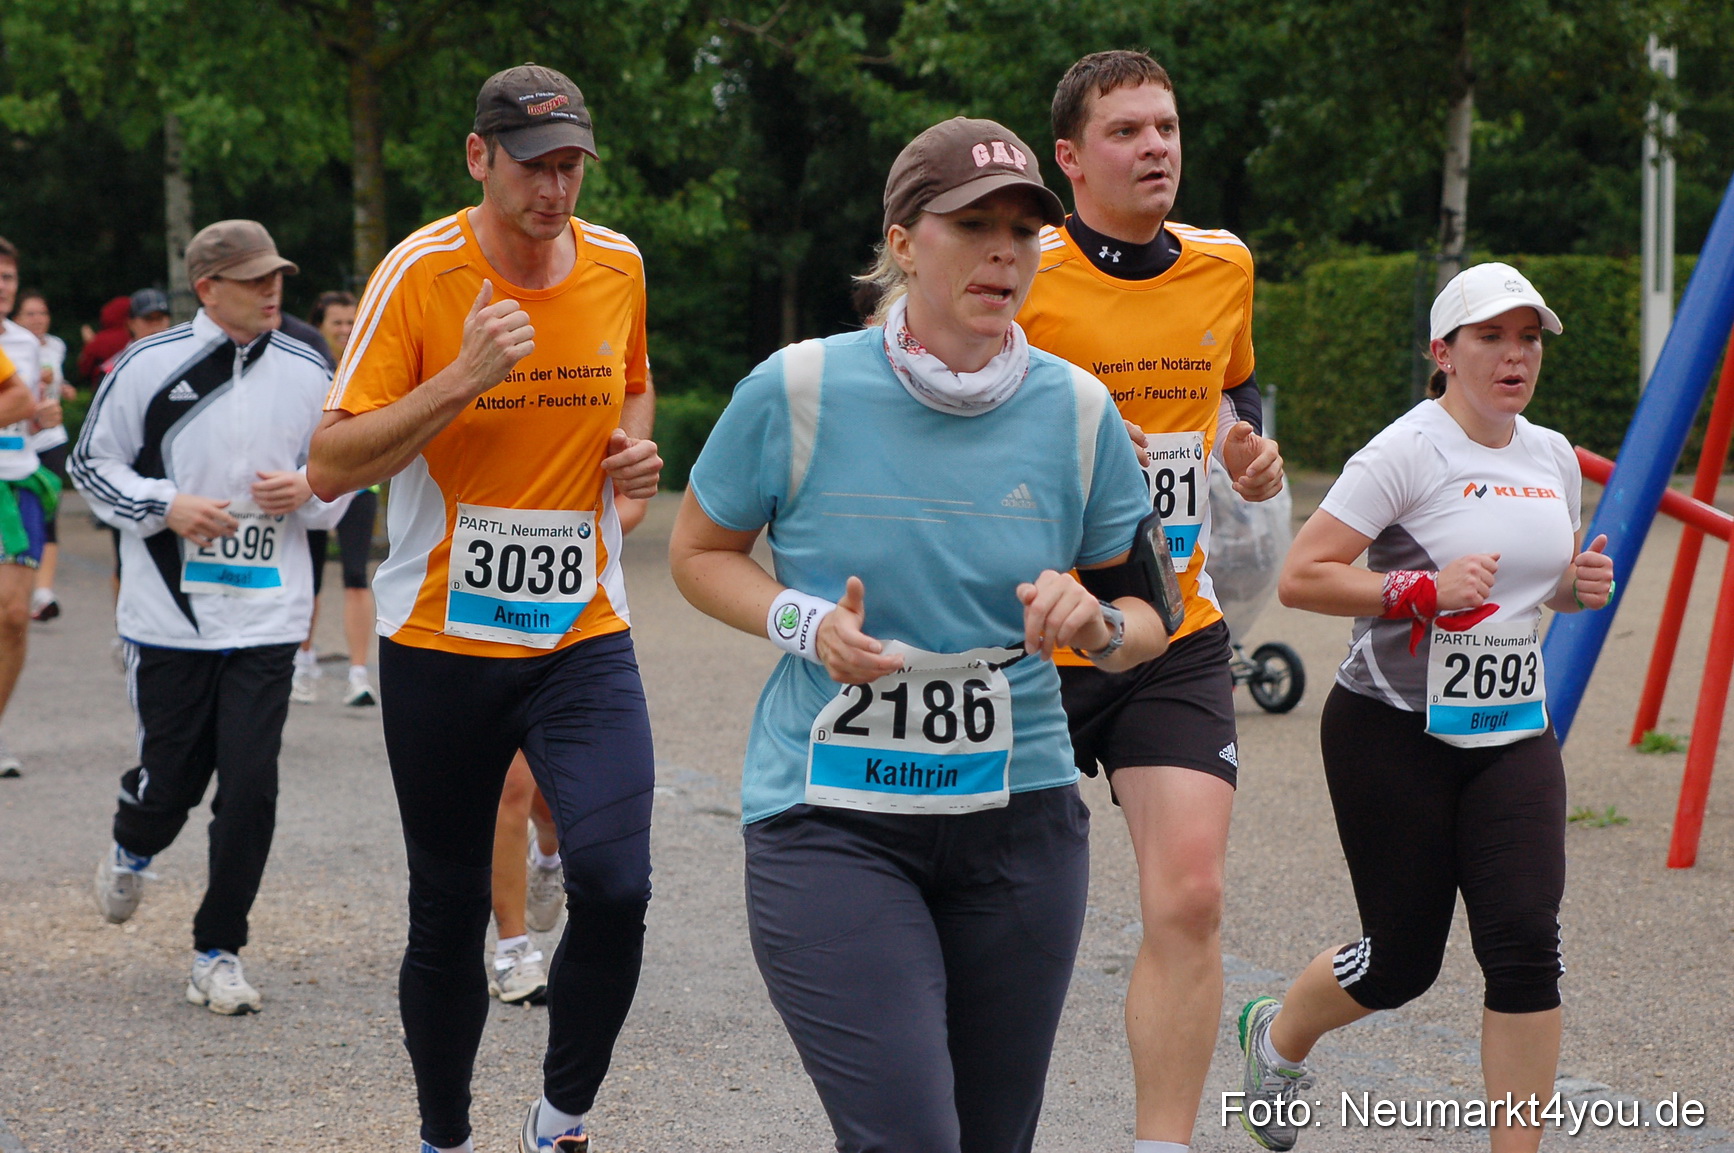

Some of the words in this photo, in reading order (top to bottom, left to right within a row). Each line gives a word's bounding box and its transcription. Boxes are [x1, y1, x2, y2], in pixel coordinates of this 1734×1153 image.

[971, 140, 1028, 170] GAP
[504, 370, 526, 383] ein
[530, 368, 552, 381] der
[557, 365, 612, 379] Notärzte
[1092, 360, 1134, 375] Verein
[1138, 358, 1158, 371] der
[1161, 357, 1212, 371] Notärzte
[475, 395, 526, 410] Altdorf
[538, 393, 587, 408] Feucht
[590, 393, 612, 406] e.V.
[1110, 387, 1135, 401] dorf
[1144, 386, 1187, 399] Feucht
[1190, 386, 1208, 400] e.V.
[1146, 447, 1190, 461] eumarkt
[1141, 466, 1196, 519] 81
[1493, 486, 1560, 499] KLEBL
[459, 516, 507, 536] PARTL
[511, 524, 573, 538] Neumarkt
[1166, 537, 1185, 552] an
[464, 539, 583, 595] 3038
[453, 581, 460, 590] D
[494, 605, 550, 628] Armin
[1434, 633, 1481, 646] PARTL
[1442, 651, 1538, 700] 2693
[832, 678, 995, 745] 2186
[1470, 710, 1509, 731] Birgit
[817, 729, 826, 741] D
[865, 757, 958, 789] Kathrin
